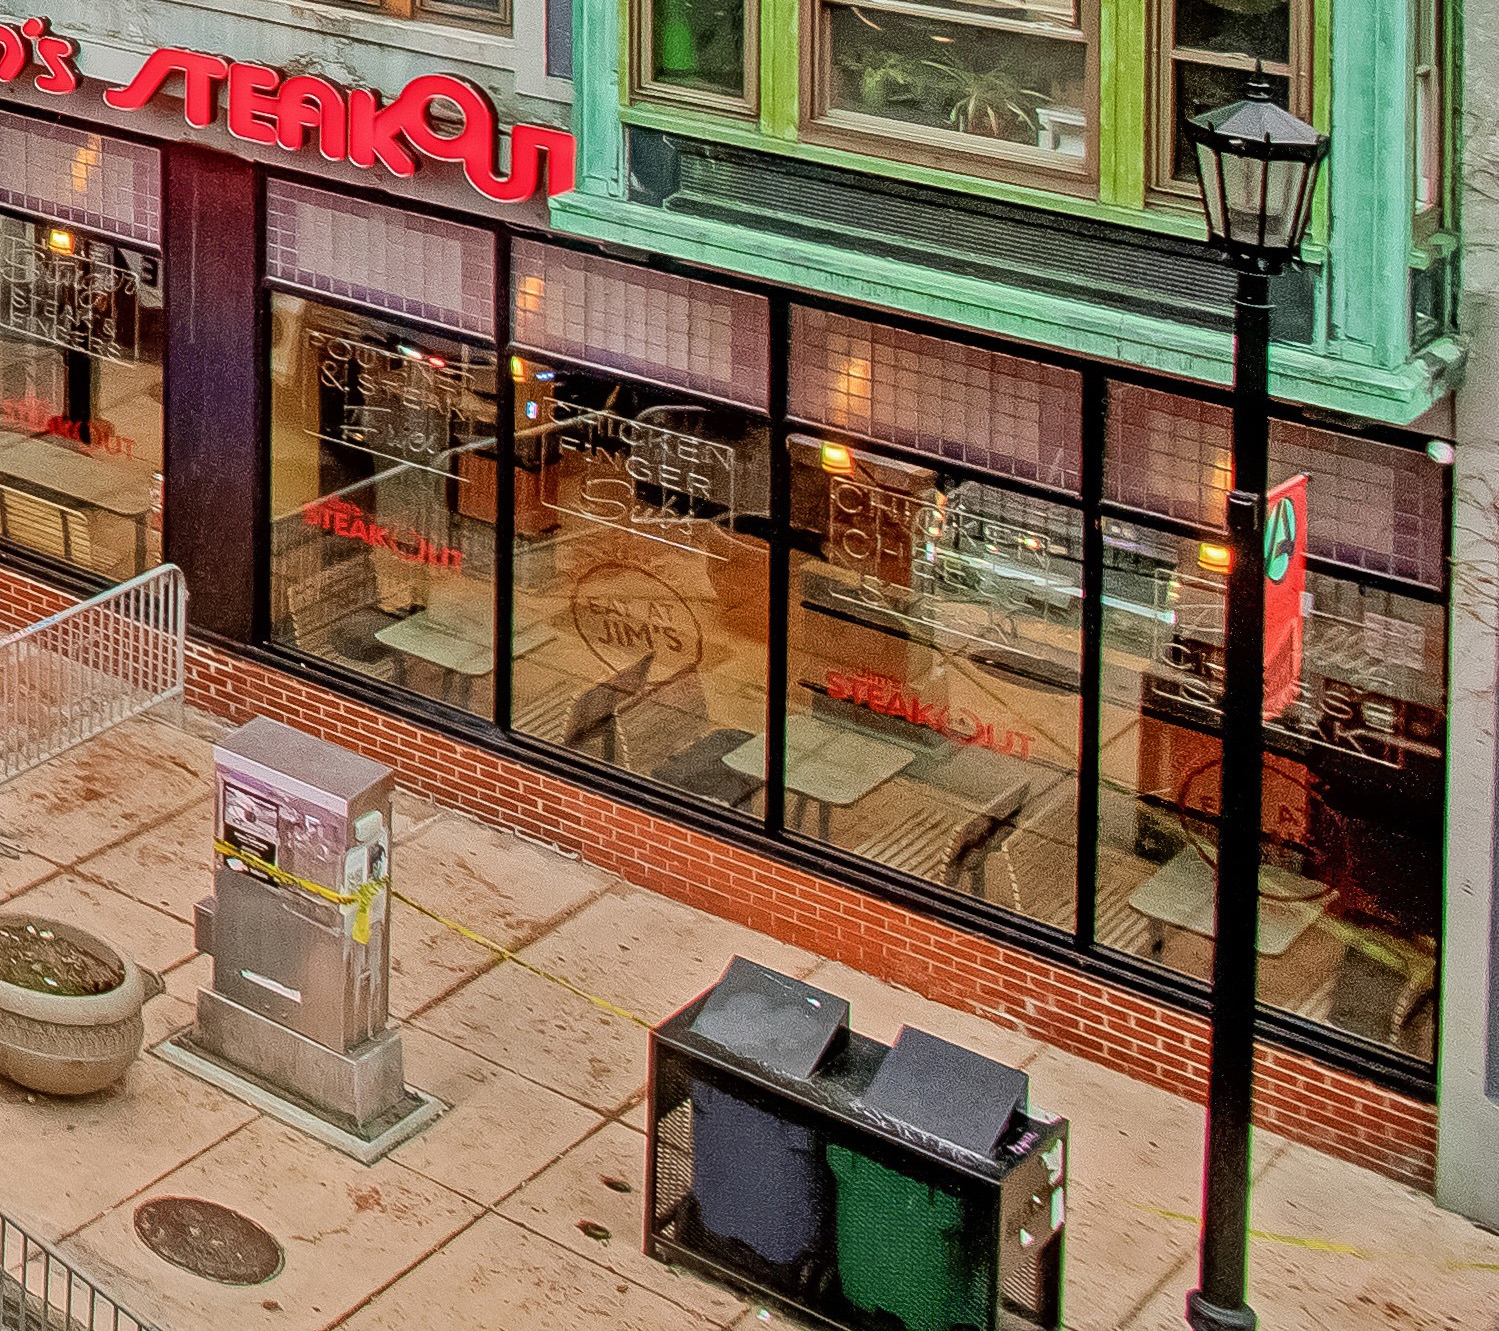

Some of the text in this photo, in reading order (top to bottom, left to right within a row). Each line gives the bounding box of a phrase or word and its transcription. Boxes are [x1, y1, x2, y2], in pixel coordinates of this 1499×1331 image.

[320, 359, 347, 392] &
[548, 400, 731, 470] CHICKEN
[559, 435, 710, 498] FINGER
[597, 620, 683, 652] JIM'S
